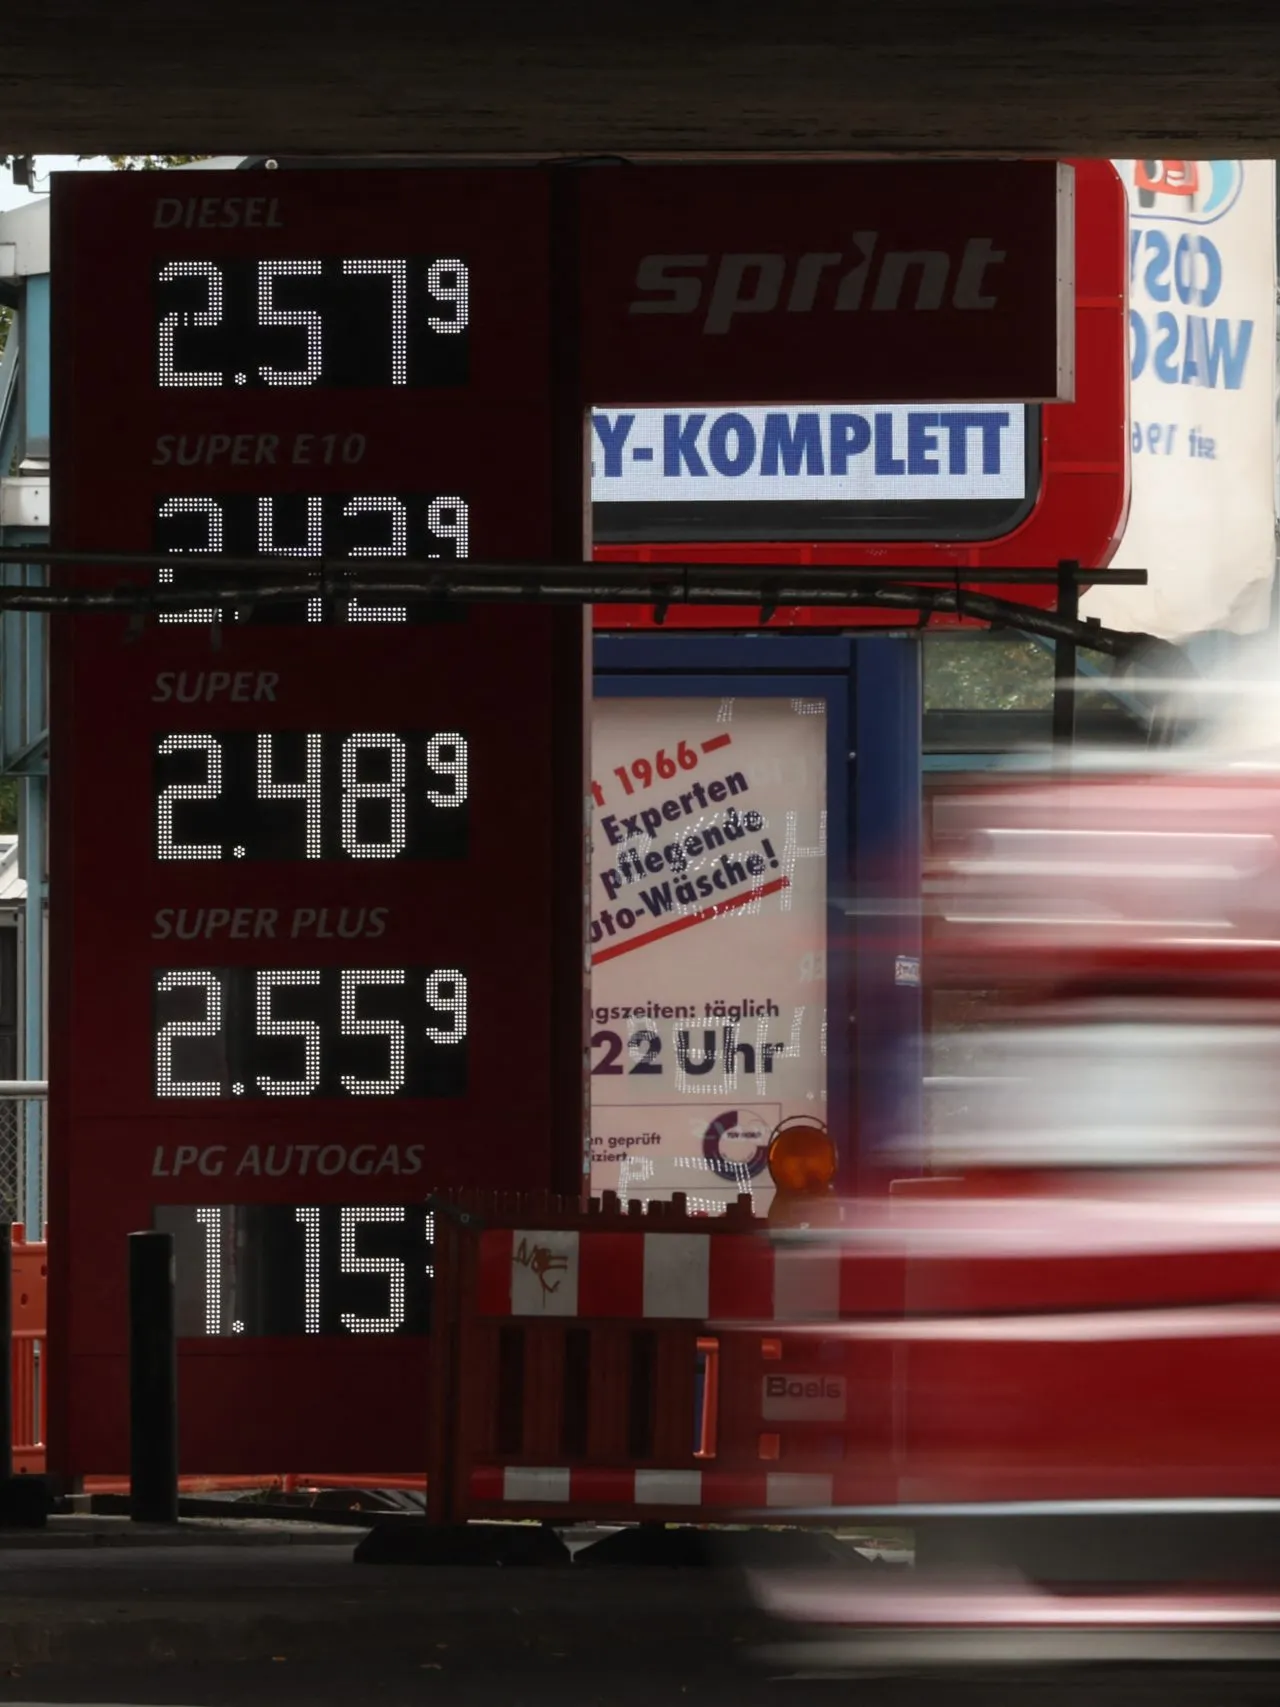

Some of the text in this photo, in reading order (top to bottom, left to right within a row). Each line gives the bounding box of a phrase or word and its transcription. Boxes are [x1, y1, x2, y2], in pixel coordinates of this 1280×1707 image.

[153, 197, 284, 229] DIESEL
[629, 231, 1006, 334] sprint
[152, 433, 366, 467] SUPER E10
[591, 412, 1009, 478] Y-KOMPLETT
[152, 671, 280, 703] SUPER
[600, 770, 749, 846] Experten
[600, 806, 763, 900] pflegende
[152, 907, 389, 940] SUPER PLUS
[704, 999, 780, 1023] täglich
[591, 1029, 784, 1075] 22 Uhr
[608, 1132, 662, 1149] geprüft
[152, 1144, 425, 1177] LPG AUTOGAS
[196, 1207, 435, 1335] 1.15
[766, 1376, 842, 1399] Boels
